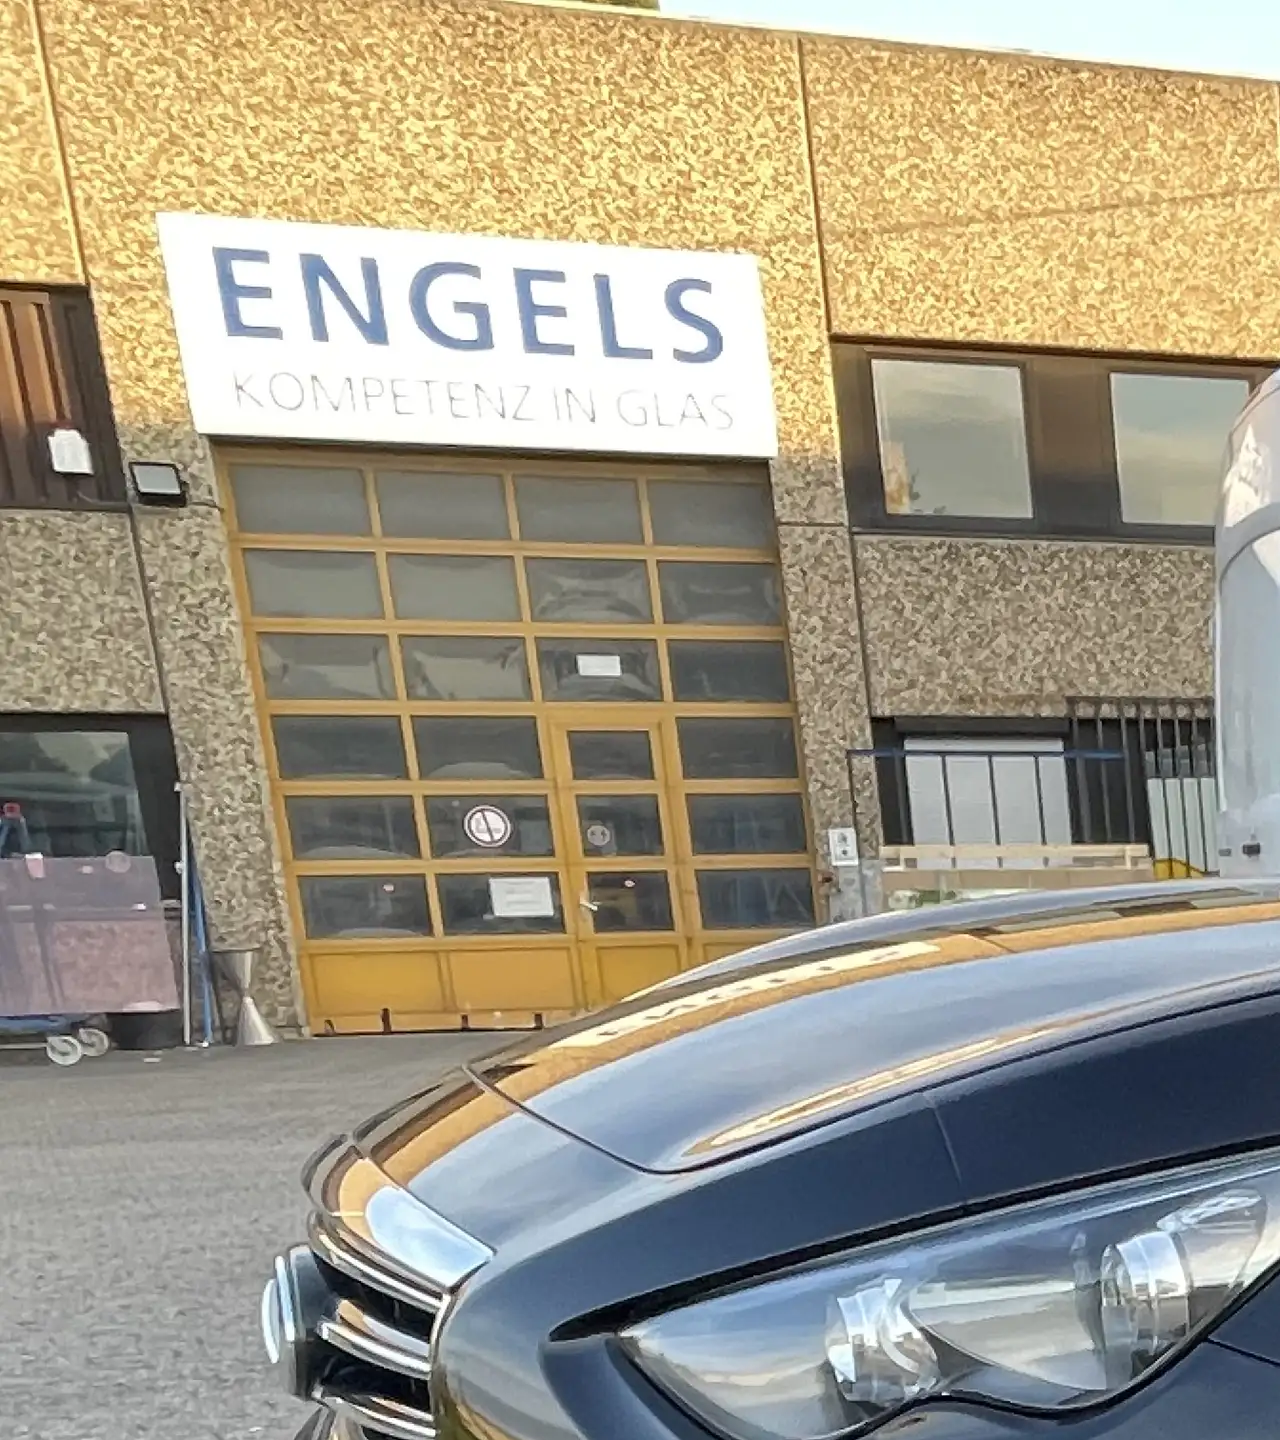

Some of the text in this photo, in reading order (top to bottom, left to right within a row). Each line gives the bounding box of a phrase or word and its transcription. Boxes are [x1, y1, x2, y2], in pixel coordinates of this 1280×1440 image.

[212, 246, 723, 363] ENGELS
[233, 370, 734, 431] KOMPETENZ IN GLAS
